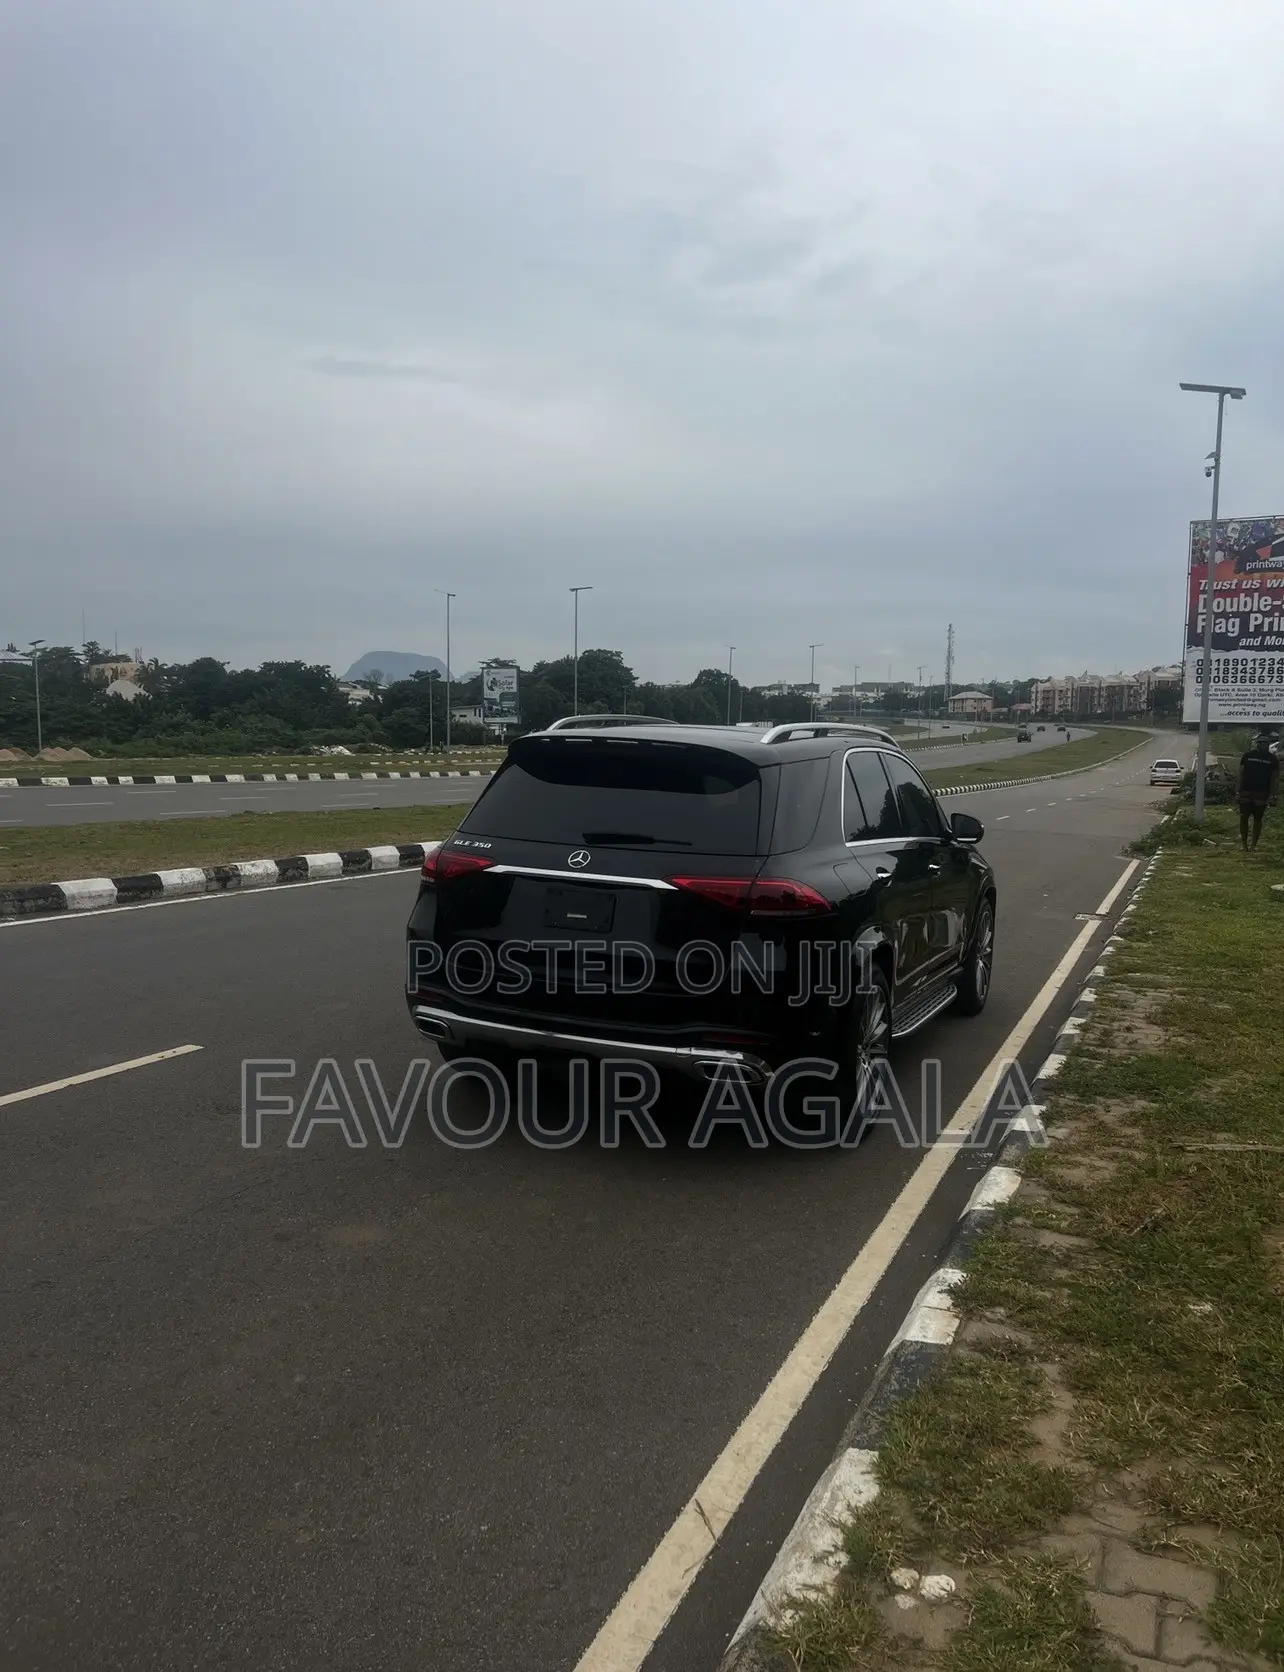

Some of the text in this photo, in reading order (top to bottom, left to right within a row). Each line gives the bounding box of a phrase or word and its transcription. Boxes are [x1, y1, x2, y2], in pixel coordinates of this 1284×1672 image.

[1246, 560, 1284, 570] printwa
[1242, 579, 1261, 589] us
[1198, 593, 1284, 613] Double-
[1239, 636, 1261, 646] and
[1197, 658, 1284, 667] 018901234
[1196, 667, 1284, 675] 018343786
[1196, 675, 1284, 684] 006366673
